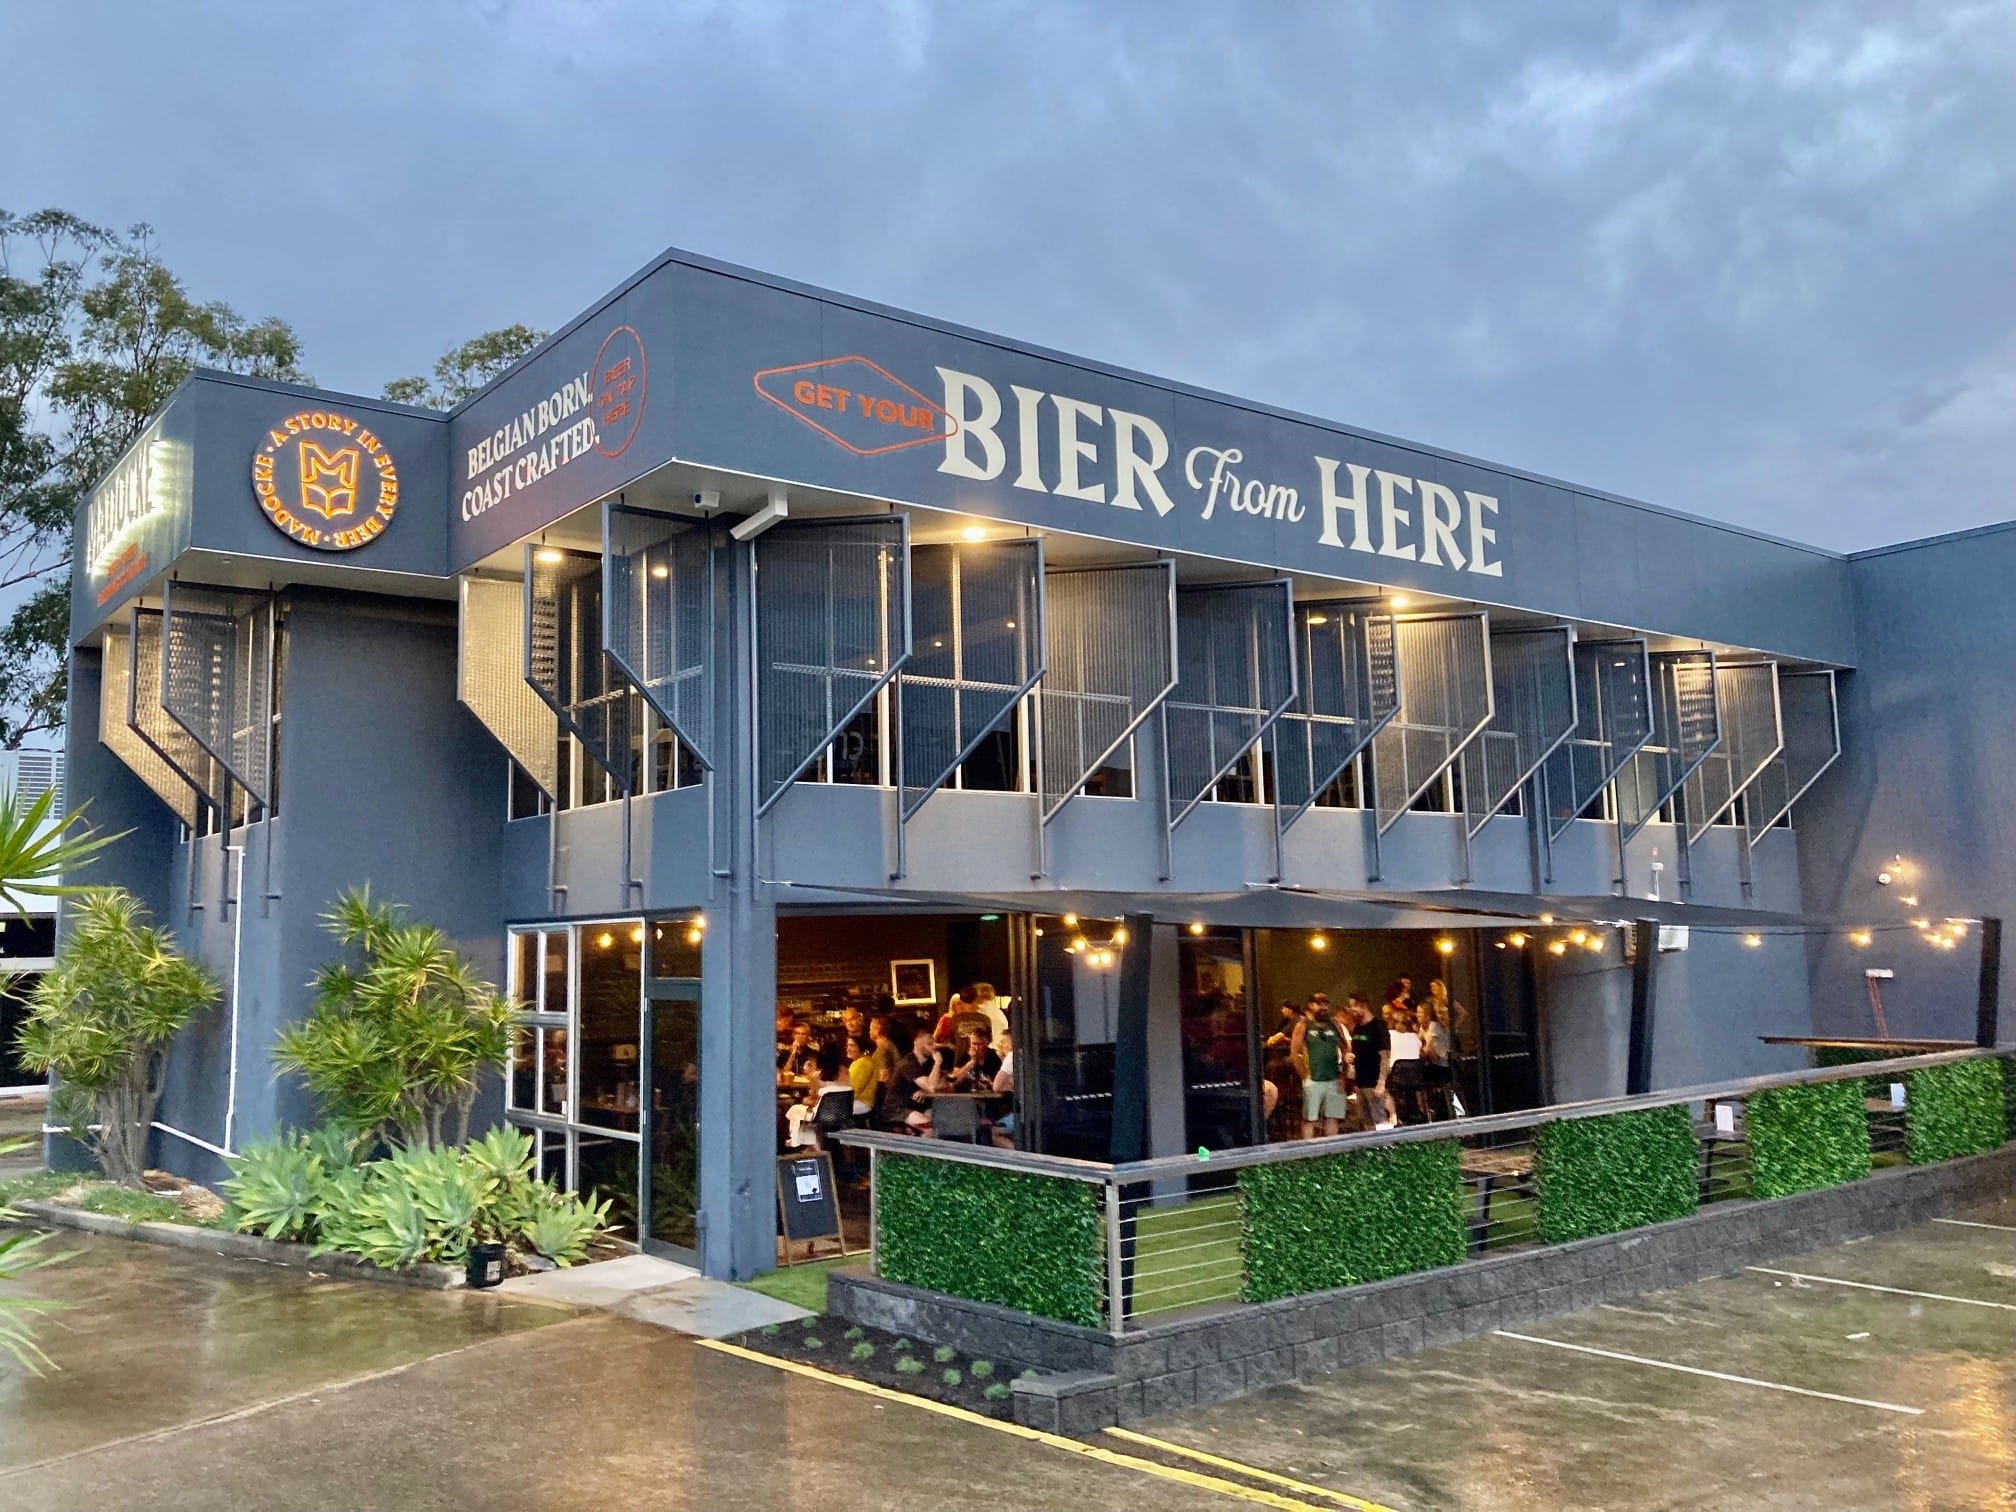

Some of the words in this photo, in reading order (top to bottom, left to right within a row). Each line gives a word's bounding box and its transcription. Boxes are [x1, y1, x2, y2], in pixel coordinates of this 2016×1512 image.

[285, 413, 358, 436] STORY
[793, 380, 851, 413] GET
[858, 394, 935, 432] YOUR
[270, 429, 290, 448] A
[356, 429, 382, 454] IN
[467, 407, 535, 480] BELGIAN
[254, 453, 322, 546] MADOCKE
[374, 453, 398, 521] EVERY
[462, 464, 513, 522] COAST
[515, 417, 600, 491] CRAFTED.
[935, 366, 1175, 518] BIER
[1185, 446, 1306, 522] From
[1314, 455, 1503, 577] HERE
[333, 516, 384, 548] BEER
